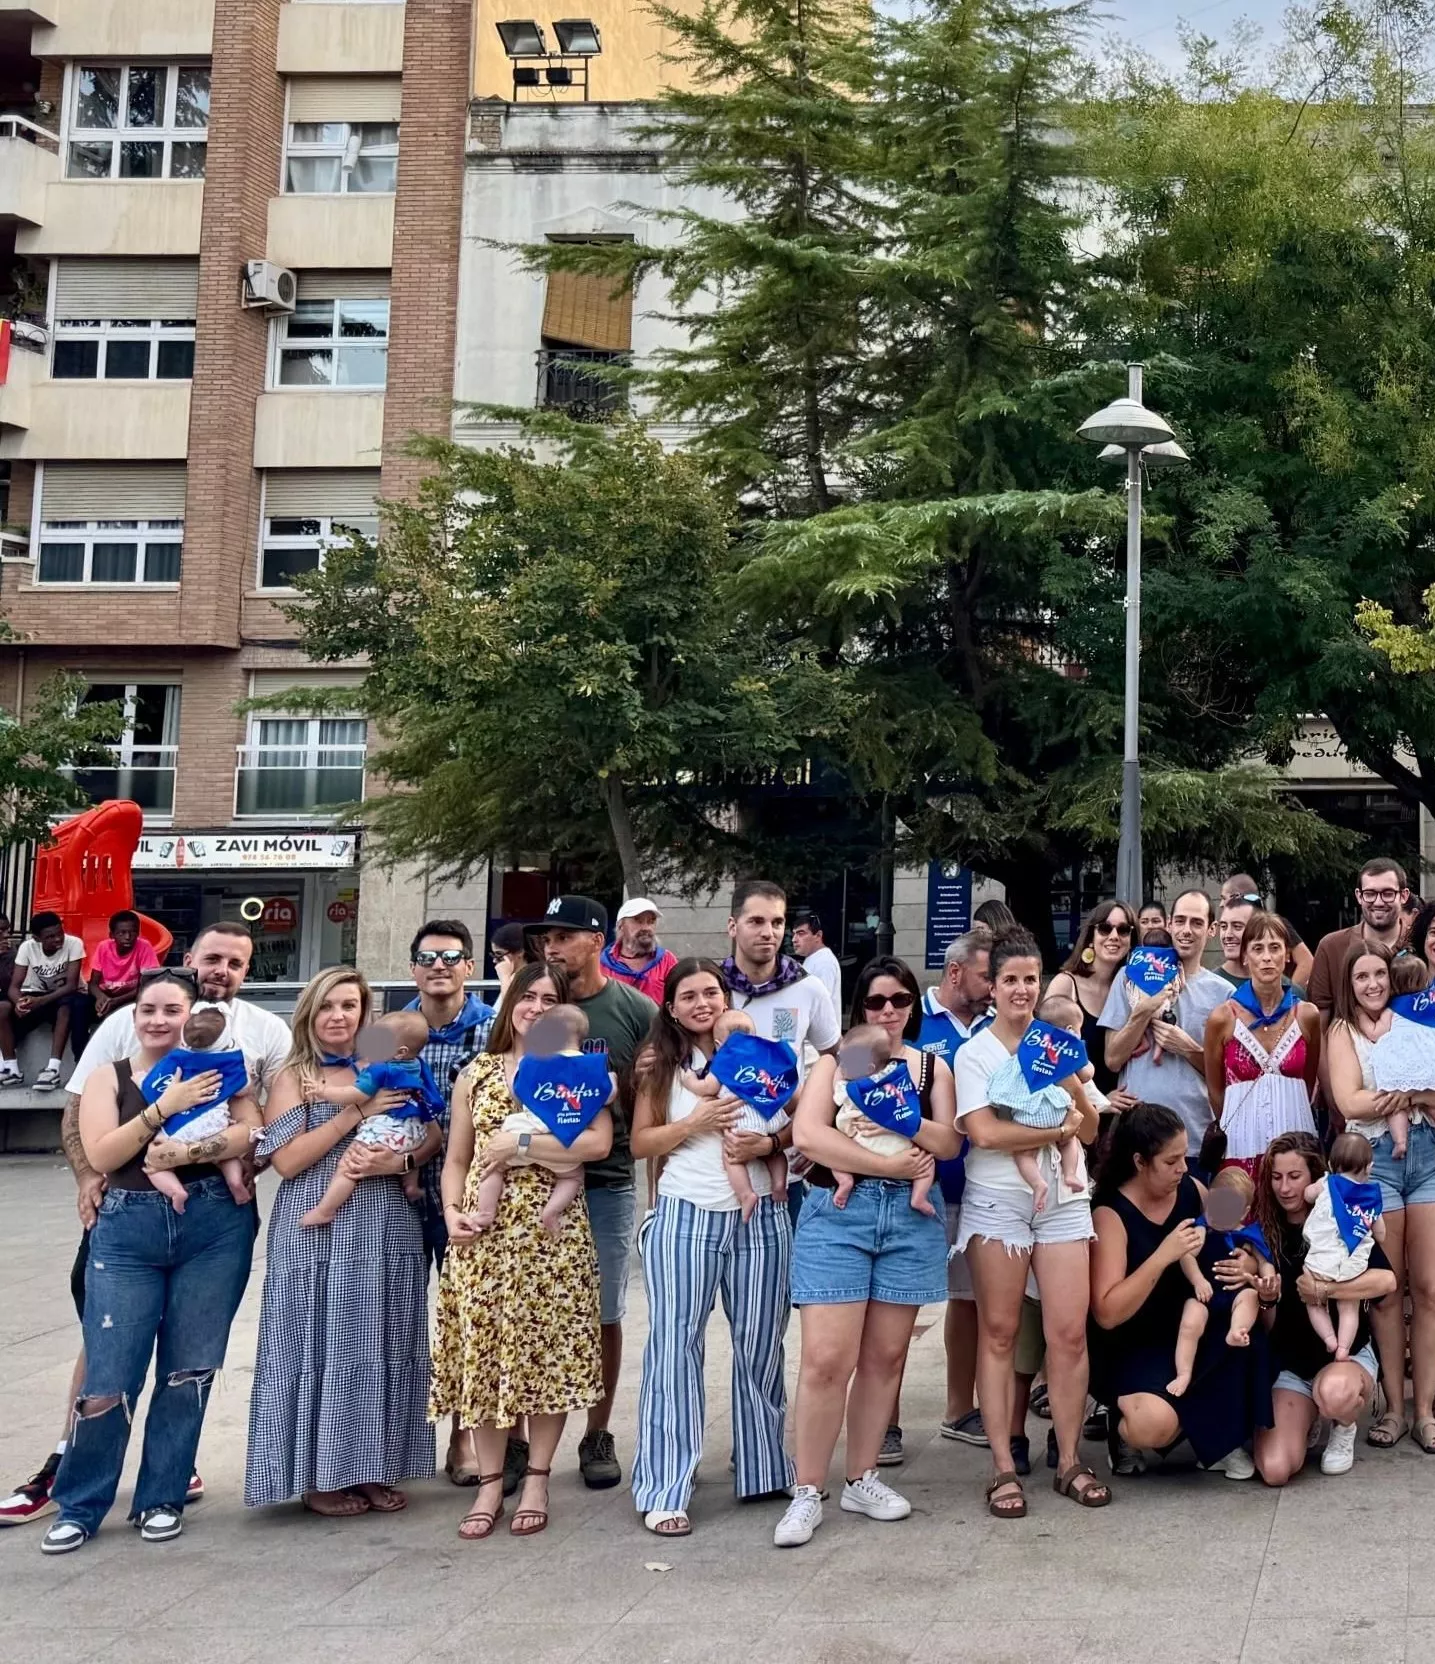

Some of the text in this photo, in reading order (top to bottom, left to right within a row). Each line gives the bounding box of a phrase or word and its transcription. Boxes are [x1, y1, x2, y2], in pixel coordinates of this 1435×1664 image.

[215, 836, 322, 852] ZAVI MÓVIL
[264, 902, 292, 920] ria
[328, 904, 346, 916] ria
